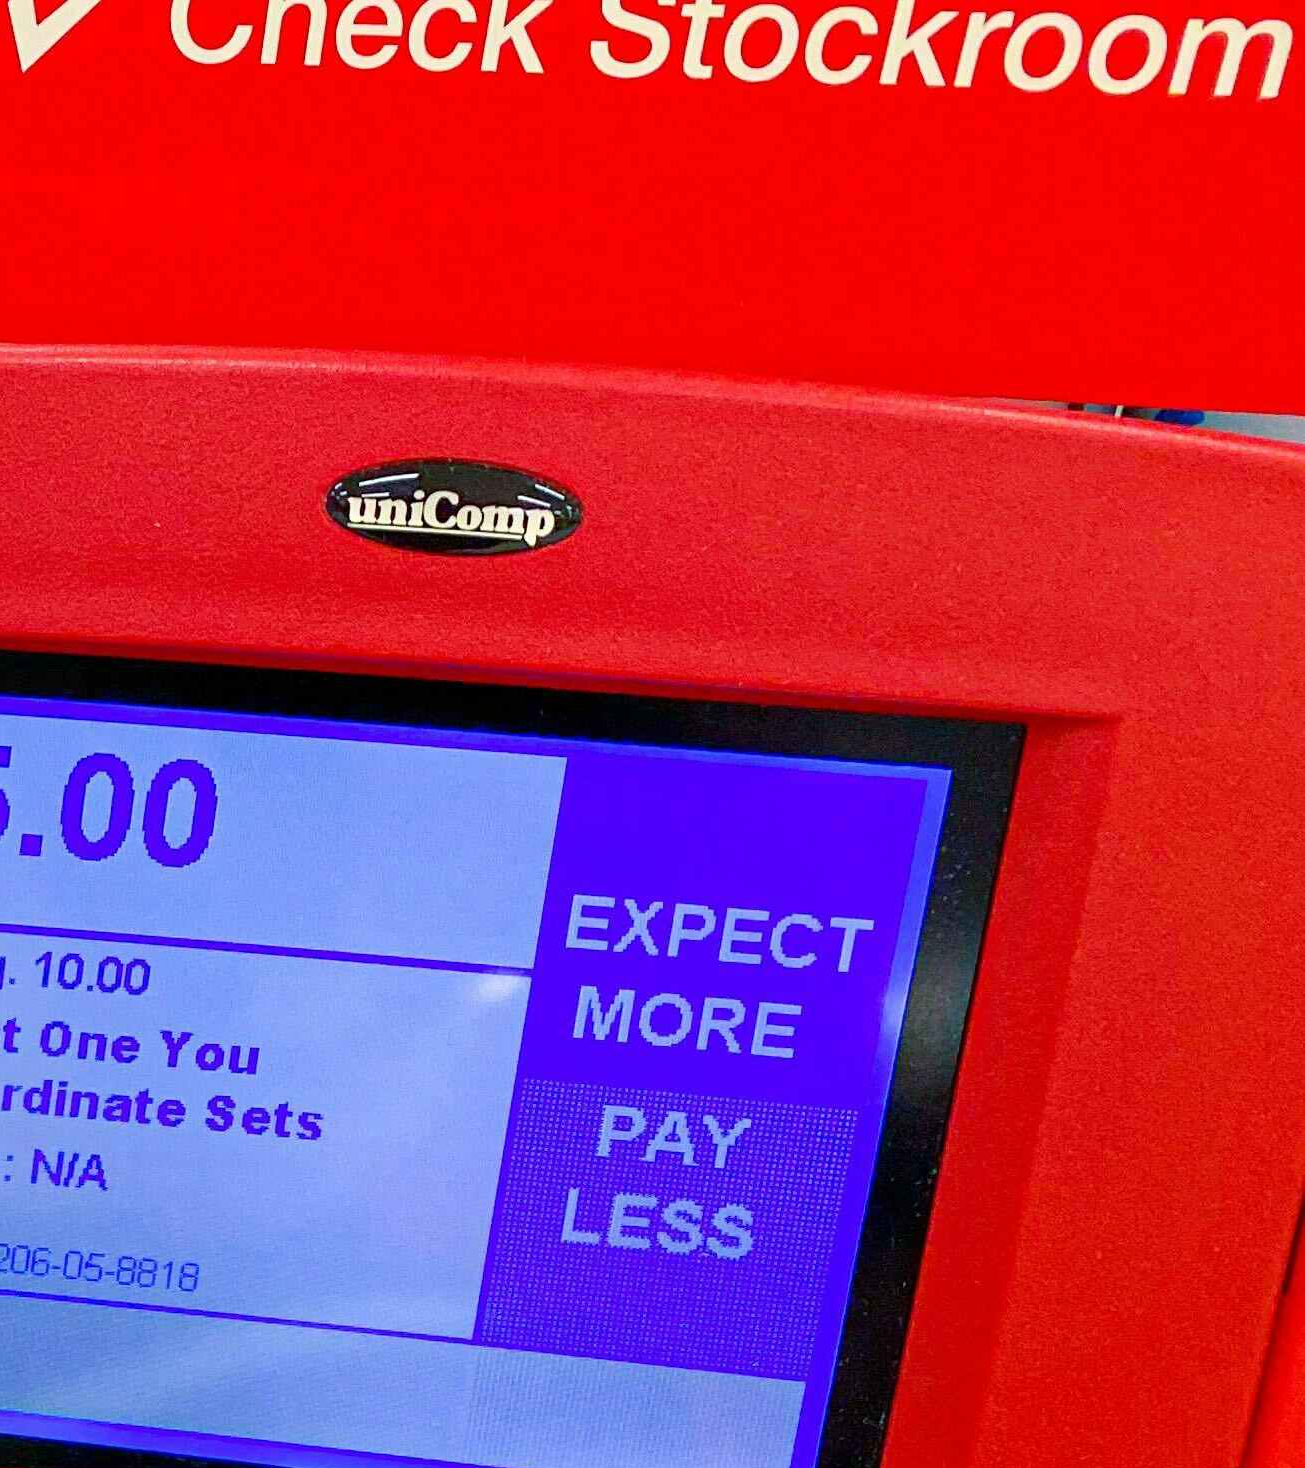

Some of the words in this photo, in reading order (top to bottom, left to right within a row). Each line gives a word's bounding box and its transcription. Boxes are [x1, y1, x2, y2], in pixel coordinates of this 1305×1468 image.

[170, 0, 554, 73] Check
[590, 0, 1292, 99] Stockroom
[348, 489, 555, 547] uniComp
[565, 894, 875, 972] EXPECT
[35, 952, 151, 995] 10.00
[40, 1020, 140, 1063] One
[160, 1030, 260, 1075] You
[572, 985, 802, 1058] MORE
[205, 1095, 324, 1141] Sets
[596, 1104, 752, 1169] PAY
[31, 1148, 108, 1191] N/A
[560, 1187, 754, 1260] LESS
